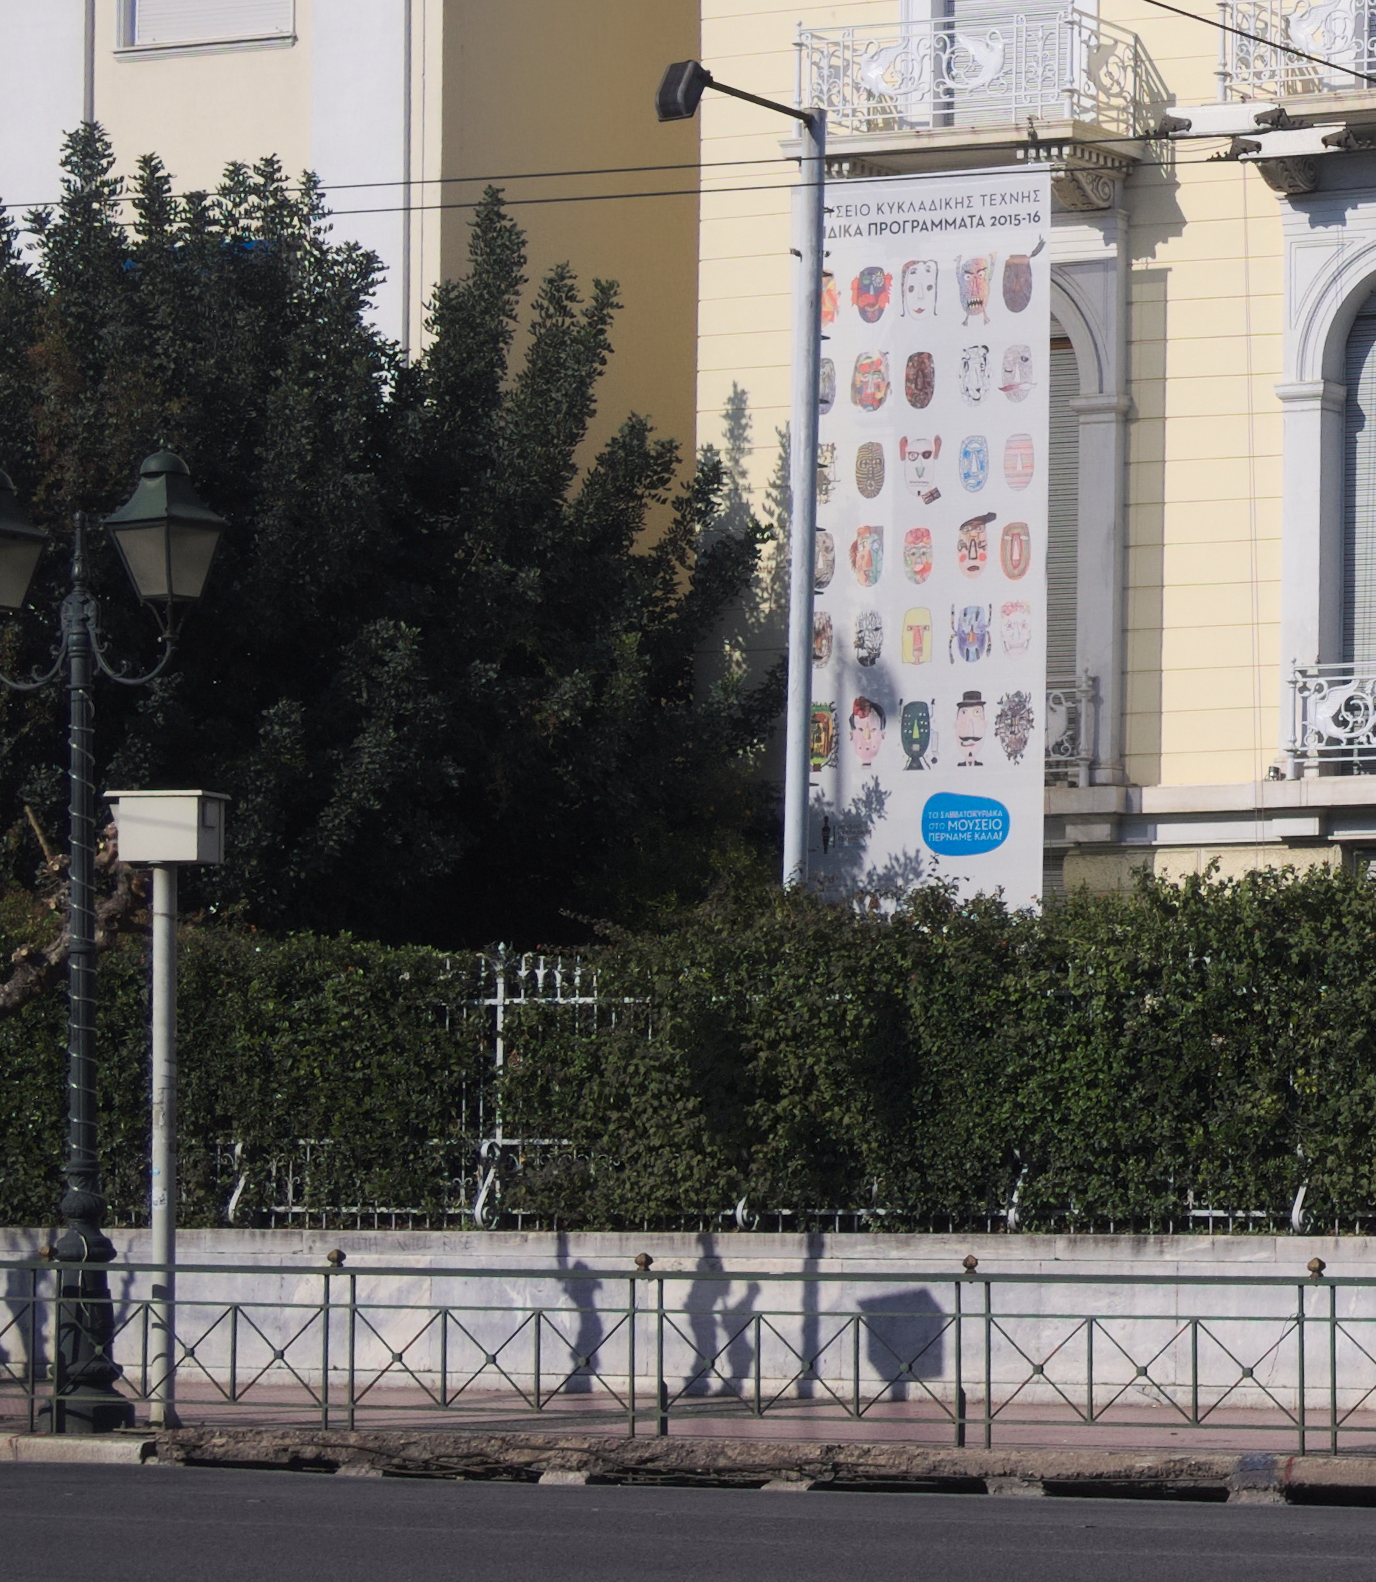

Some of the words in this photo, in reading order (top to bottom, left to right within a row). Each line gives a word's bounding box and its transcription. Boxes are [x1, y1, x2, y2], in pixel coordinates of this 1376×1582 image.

[827, 203, 871, 219] ΥΣΕΙΟ
[877, 195, 974, 215] ΚΥΚΛΑΔΙΚΗΣ
[980, 189, 1040, 206] ΤΕΧΝΗΣ
[868, 214, 985, 236] ΠΡΟΓΡΑΜΜΑΤΑ
[990, 210, 1041, 227] 2015-16
[947, 819, 1002, 831] ΜΟΥΣΕΙΟ
[928, 832, 972, 841] ΠΕΡΝΑΜΕ
